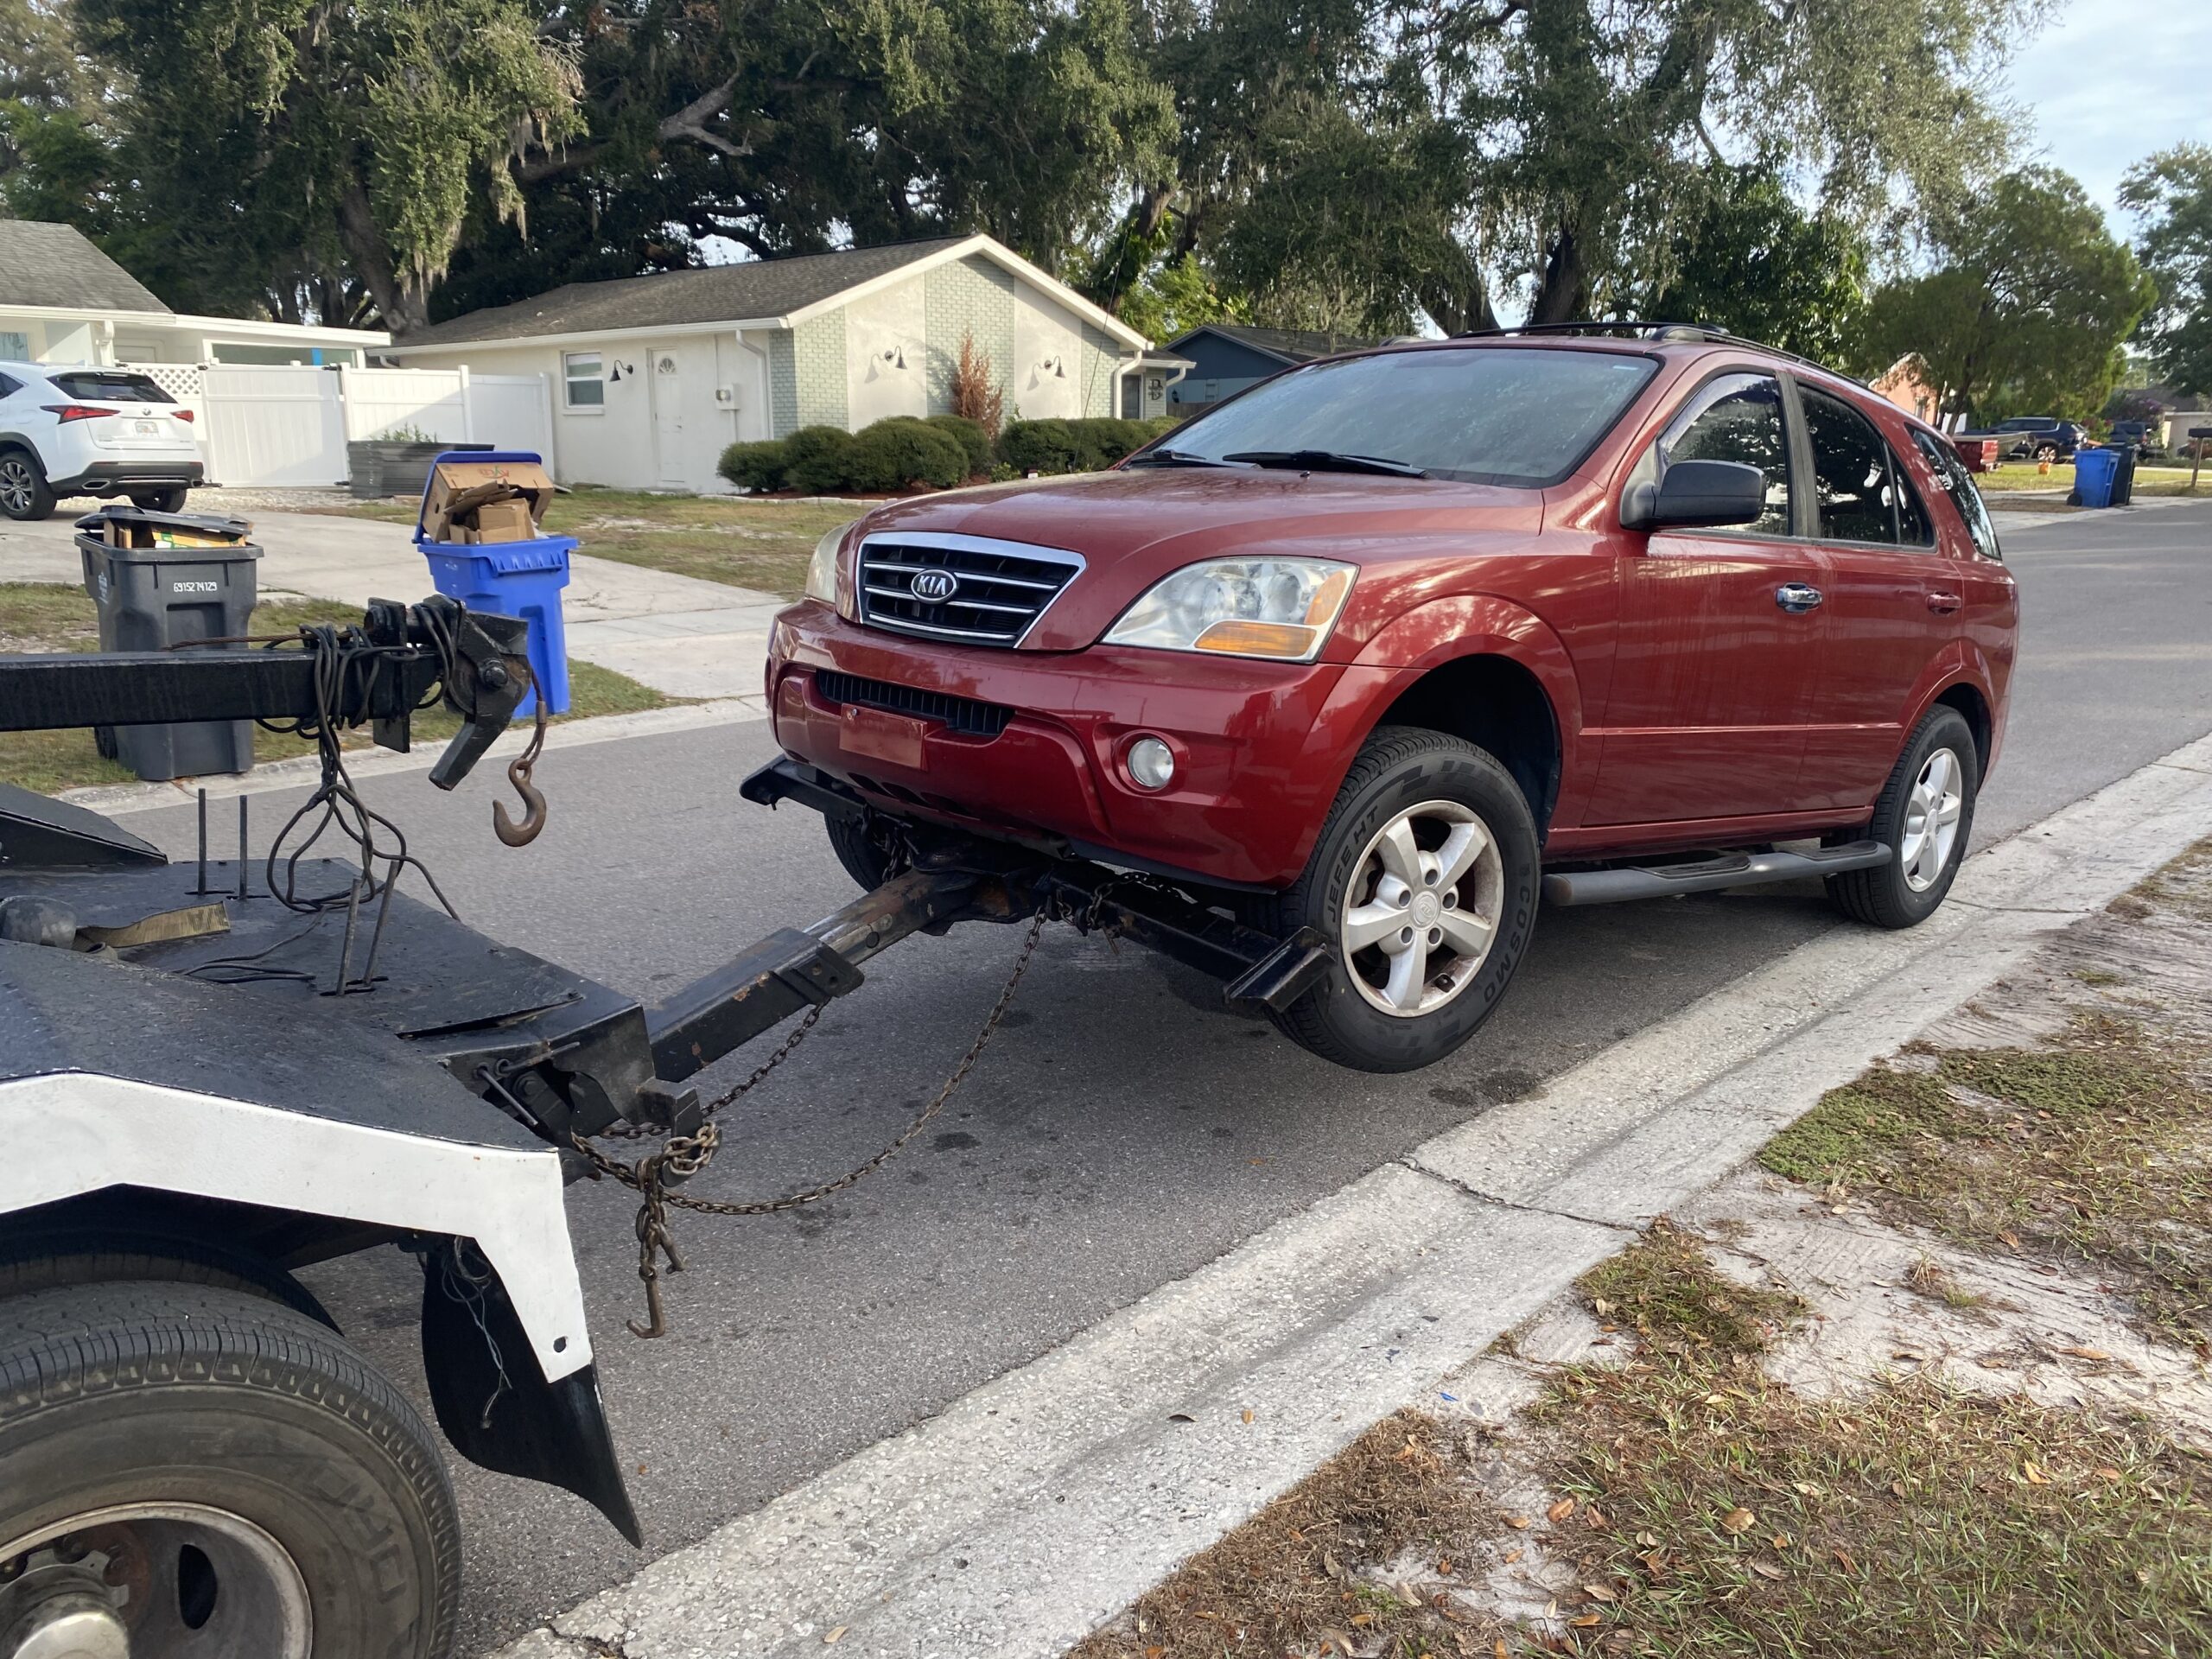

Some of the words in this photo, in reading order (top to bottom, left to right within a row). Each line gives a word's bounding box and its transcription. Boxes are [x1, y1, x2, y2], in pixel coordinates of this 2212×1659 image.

[917, 575, 946, 595] KIA
[1327, 845, 1352, 924] JEFE
[1353, 805, 1378, 844] HT
[1484, 885, 1531, 1003] COSMO
